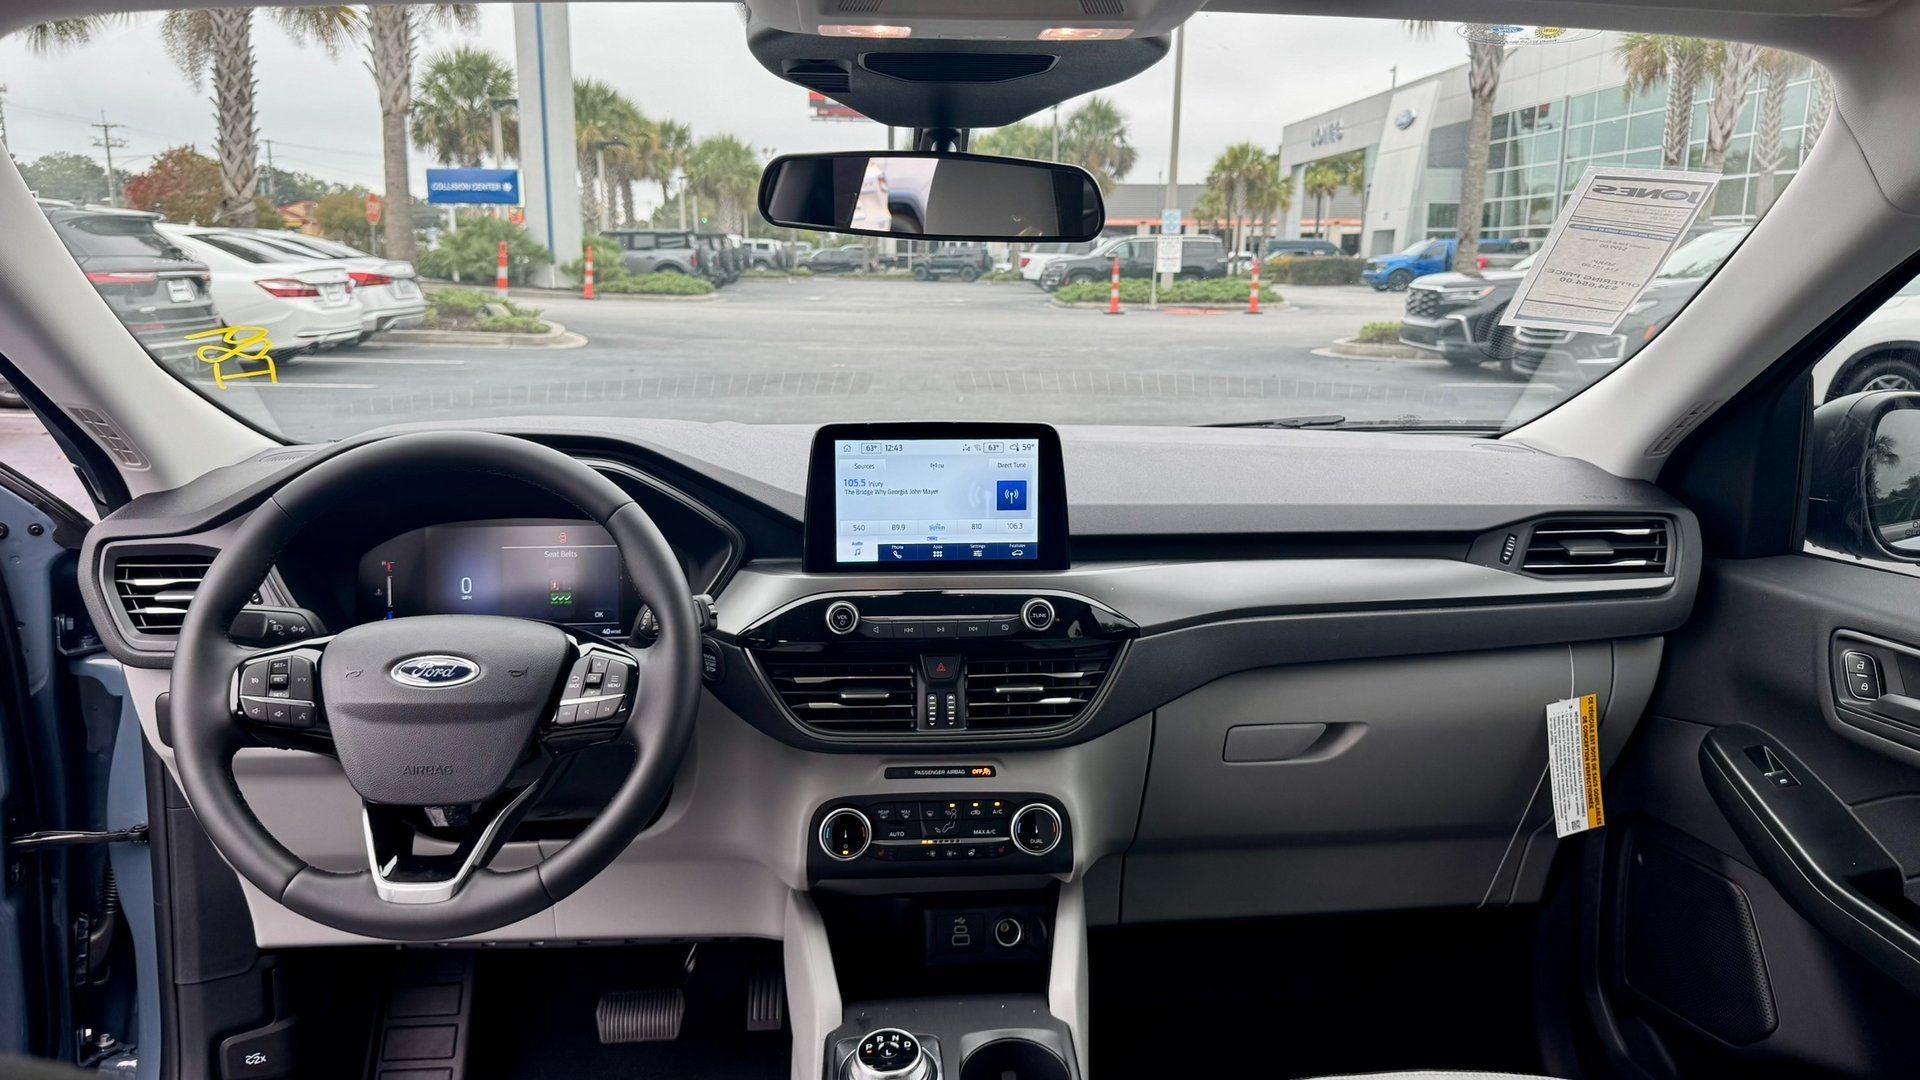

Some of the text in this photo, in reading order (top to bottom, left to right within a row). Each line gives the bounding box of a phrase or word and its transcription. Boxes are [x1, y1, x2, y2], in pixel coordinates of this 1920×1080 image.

[431, 182, 500, 192] COLLISION CENTER
[844, 479, 866, 487] 105.5
[462, 576, 472, 594] 0
[412, 661, 457, 678] Ford
[402, 765, 454, 776] AIRBAG
